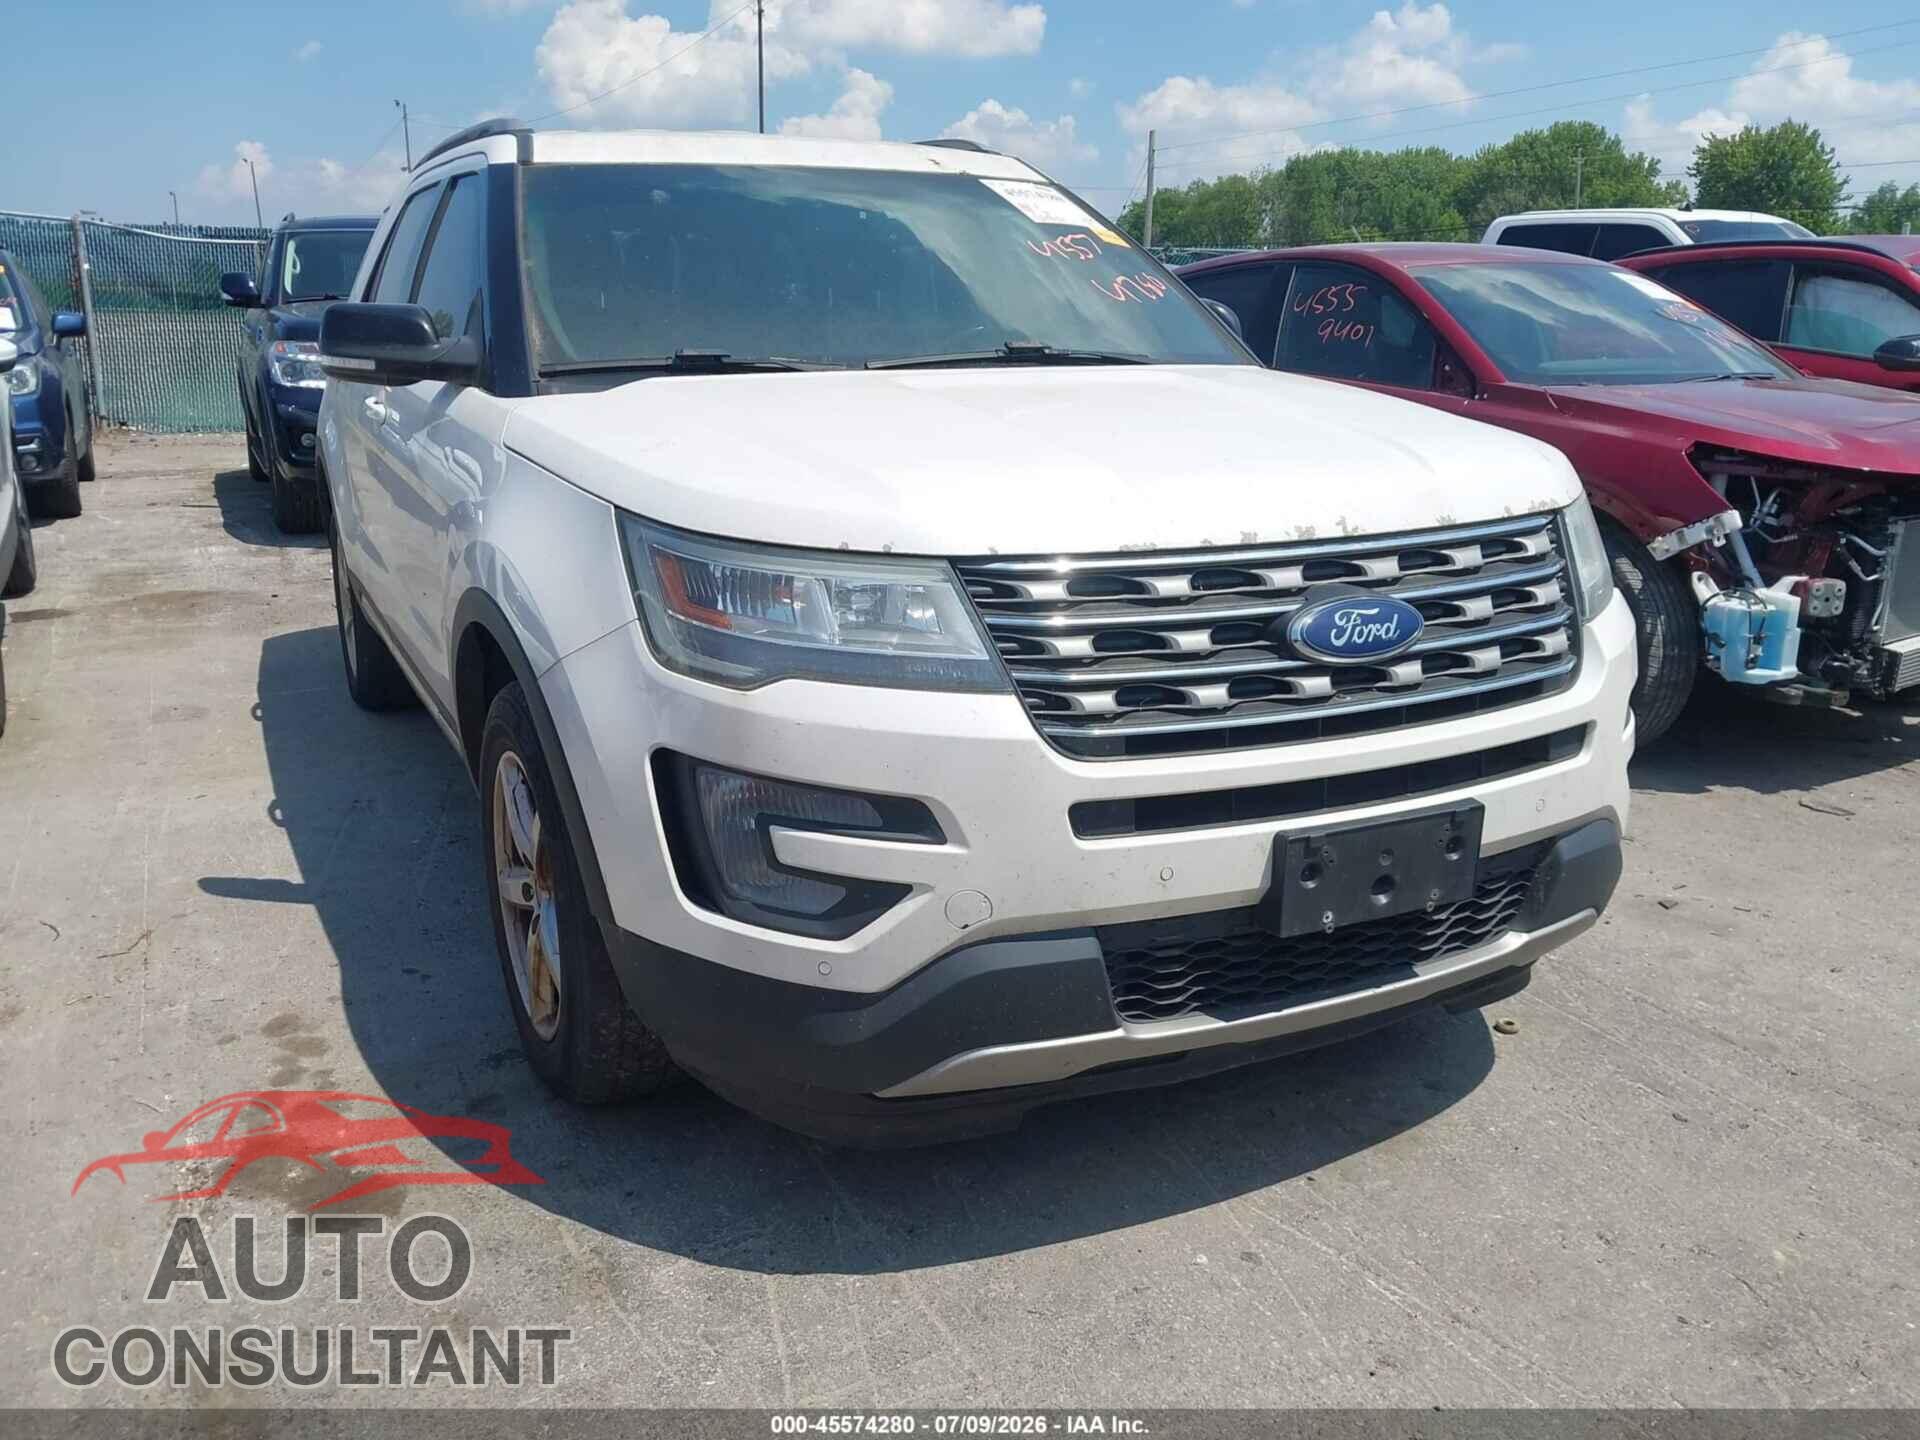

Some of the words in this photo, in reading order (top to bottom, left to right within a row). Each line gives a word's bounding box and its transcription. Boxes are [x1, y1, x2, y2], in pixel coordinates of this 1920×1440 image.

[1293, 283, 1369, 317] 4555
[1317, 318, 1375, 348] 9401
[1330, 607, 1401, 647] Ford
